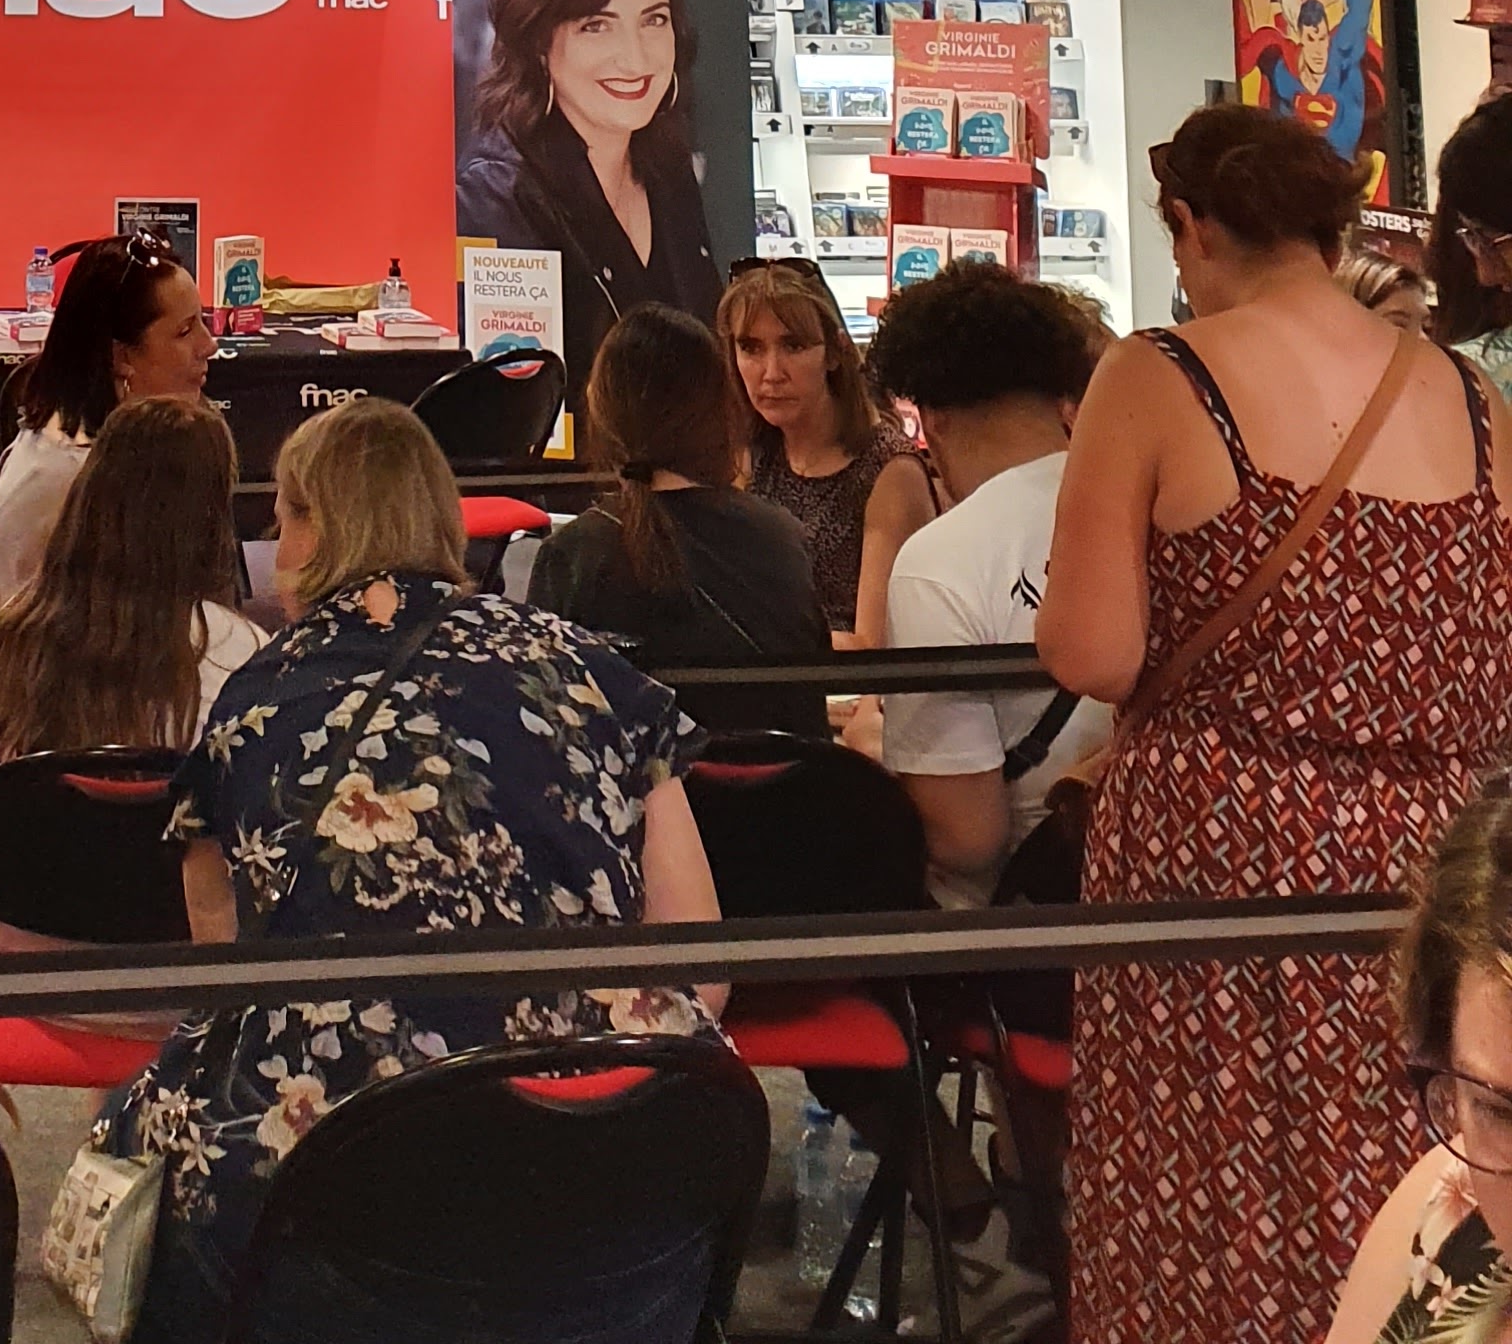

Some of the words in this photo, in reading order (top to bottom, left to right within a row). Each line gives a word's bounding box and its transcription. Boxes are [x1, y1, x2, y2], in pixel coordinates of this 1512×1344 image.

[943, 32, 1000, 44] VIRGINIE
[925, 41, 1016, 59] GRIMALDI
[901, 96, 948, 107] GRIMALDI
[962, 101, 1008, 111] GRIMALDI
[473, 256, 549, 270] NOUVEAUTÉ
[473, 270, 484, 282] IL
[486, 270, 523, 283] NOUS
[474, 284, 527, 297] RESTERA
[529, 286, 549, 301] ÇA
[492, 310, 535, 320] VIRGINIE
[480, 319, 547, 333] GRIMALDI
